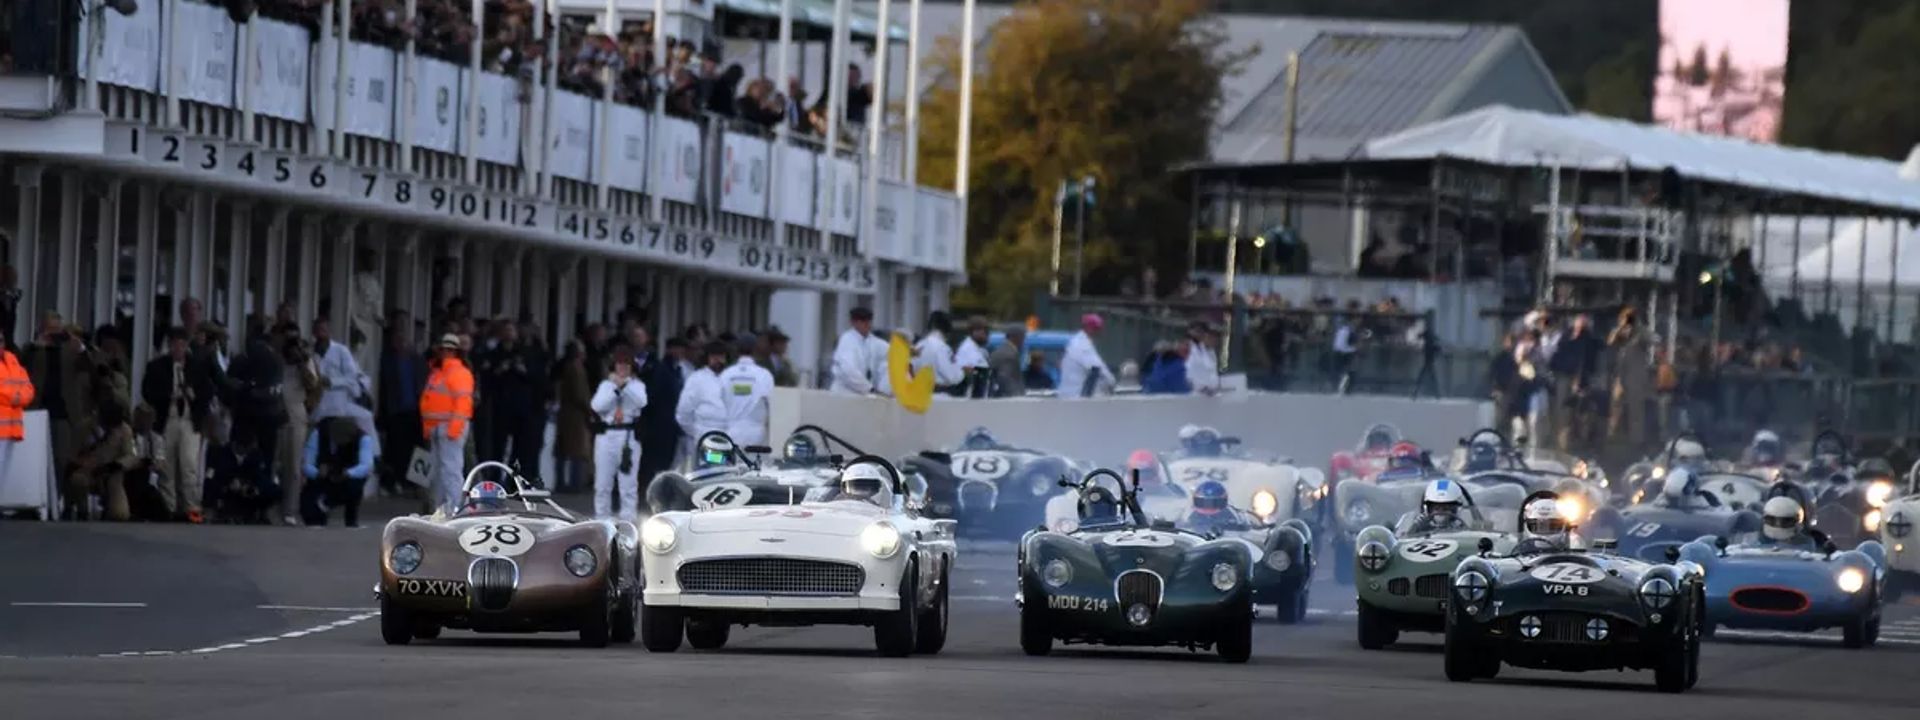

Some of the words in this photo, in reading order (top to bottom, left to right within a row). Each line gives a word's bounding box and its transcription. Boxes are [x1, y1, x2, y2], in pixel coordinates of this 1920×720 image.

[132, 128, 138, 154] 1
[163, 136, 179, 162] 2
[201, 144, 217, 169] 3
[238, 152, 255, 176] 4
[274, 158, 290, 182] 5
[310, 165, 326, 188] 6
[362, 173, 377, 198] 7
[395, 180, 411, 204] 8
[430, 187, 446, 211] 9
[961, 455, 1000, 475] 18
[702, 485, 742, 506] 16
[469, 524, 521, 546] 38
[1626, 522, 1661, 538] 19
[399, 579, 421, 595] 70
[424, 580, 465, 597] XVK
[1542, 584, 1574, 595] VPA
[1577, 586, 1589, 596] 8
[1047, 594, 1080, 609] MDU
[1083, 597, 1109, 612] 214
